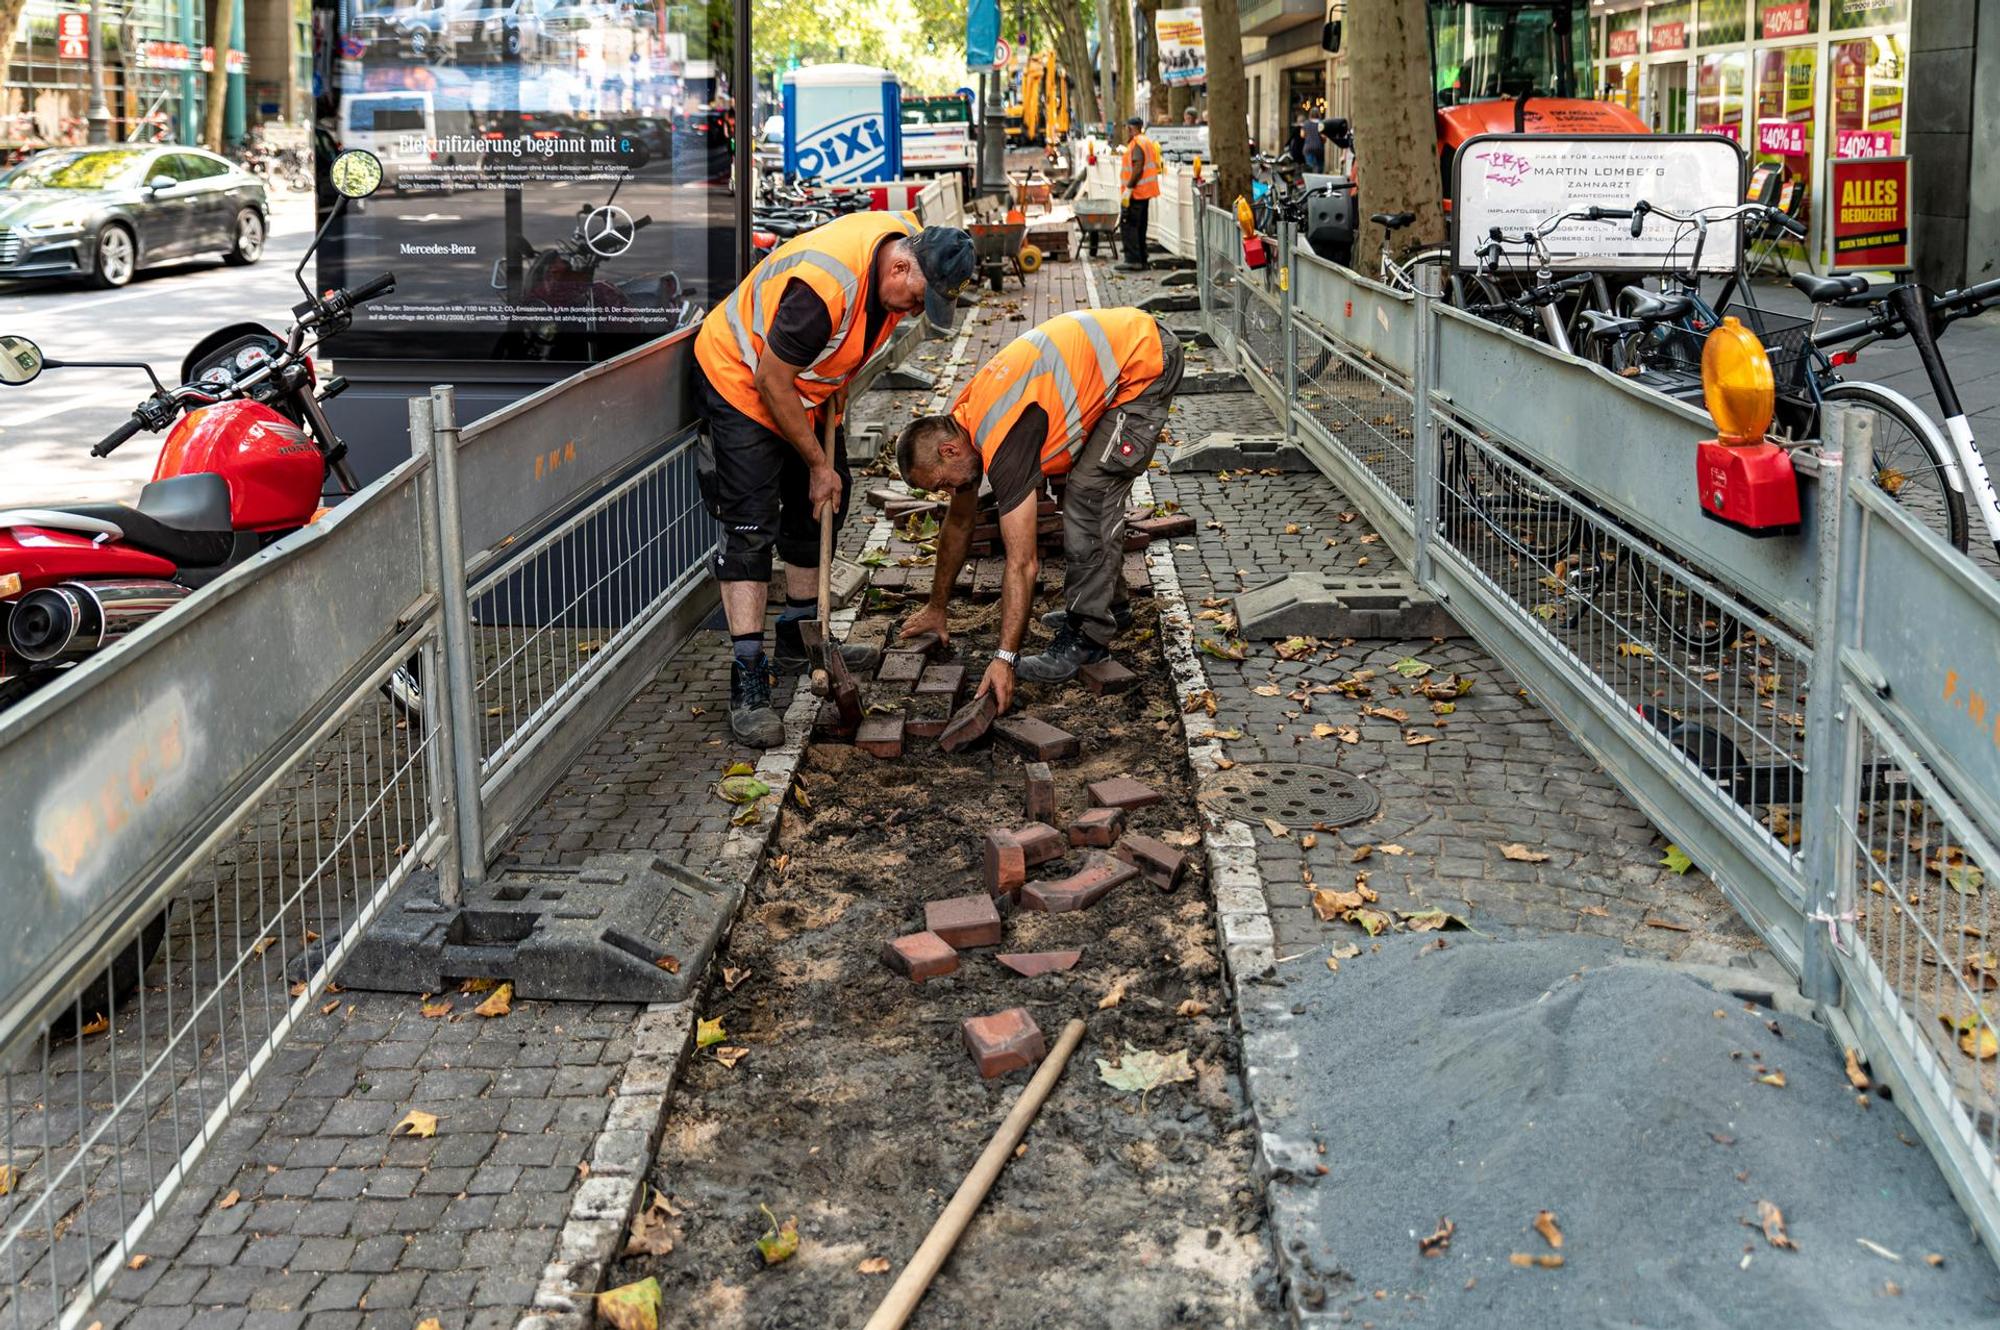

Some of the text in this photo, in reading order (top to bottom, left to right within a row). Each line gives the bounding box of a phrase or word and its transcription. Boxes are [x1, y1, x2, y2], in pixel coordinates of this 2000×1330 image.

[399, 134, 634, 157] Elektrifizierung beginnt mit e.
[529, 164, 542, 172] ohne
[543, 164, 558, 172] lokale
[1534, 167, 1665, 176] MARTIN LOMBEG
[1841, 179, 1898, 207] ALLES
[1840, 206, 1898, 223] REDUZIERT
[400, 243, 477, 255] Mercedes-Benz
[403, 305, 444, 313] Stromverbrauch
[623, 306, 665, 314] Stromverbrauch
[512, 315, 553, 323] Stromverbrauch
[562, 315, 587, 323] abhängig
[608, 316, 668, 324] Fahrzeugkonfiguration.
